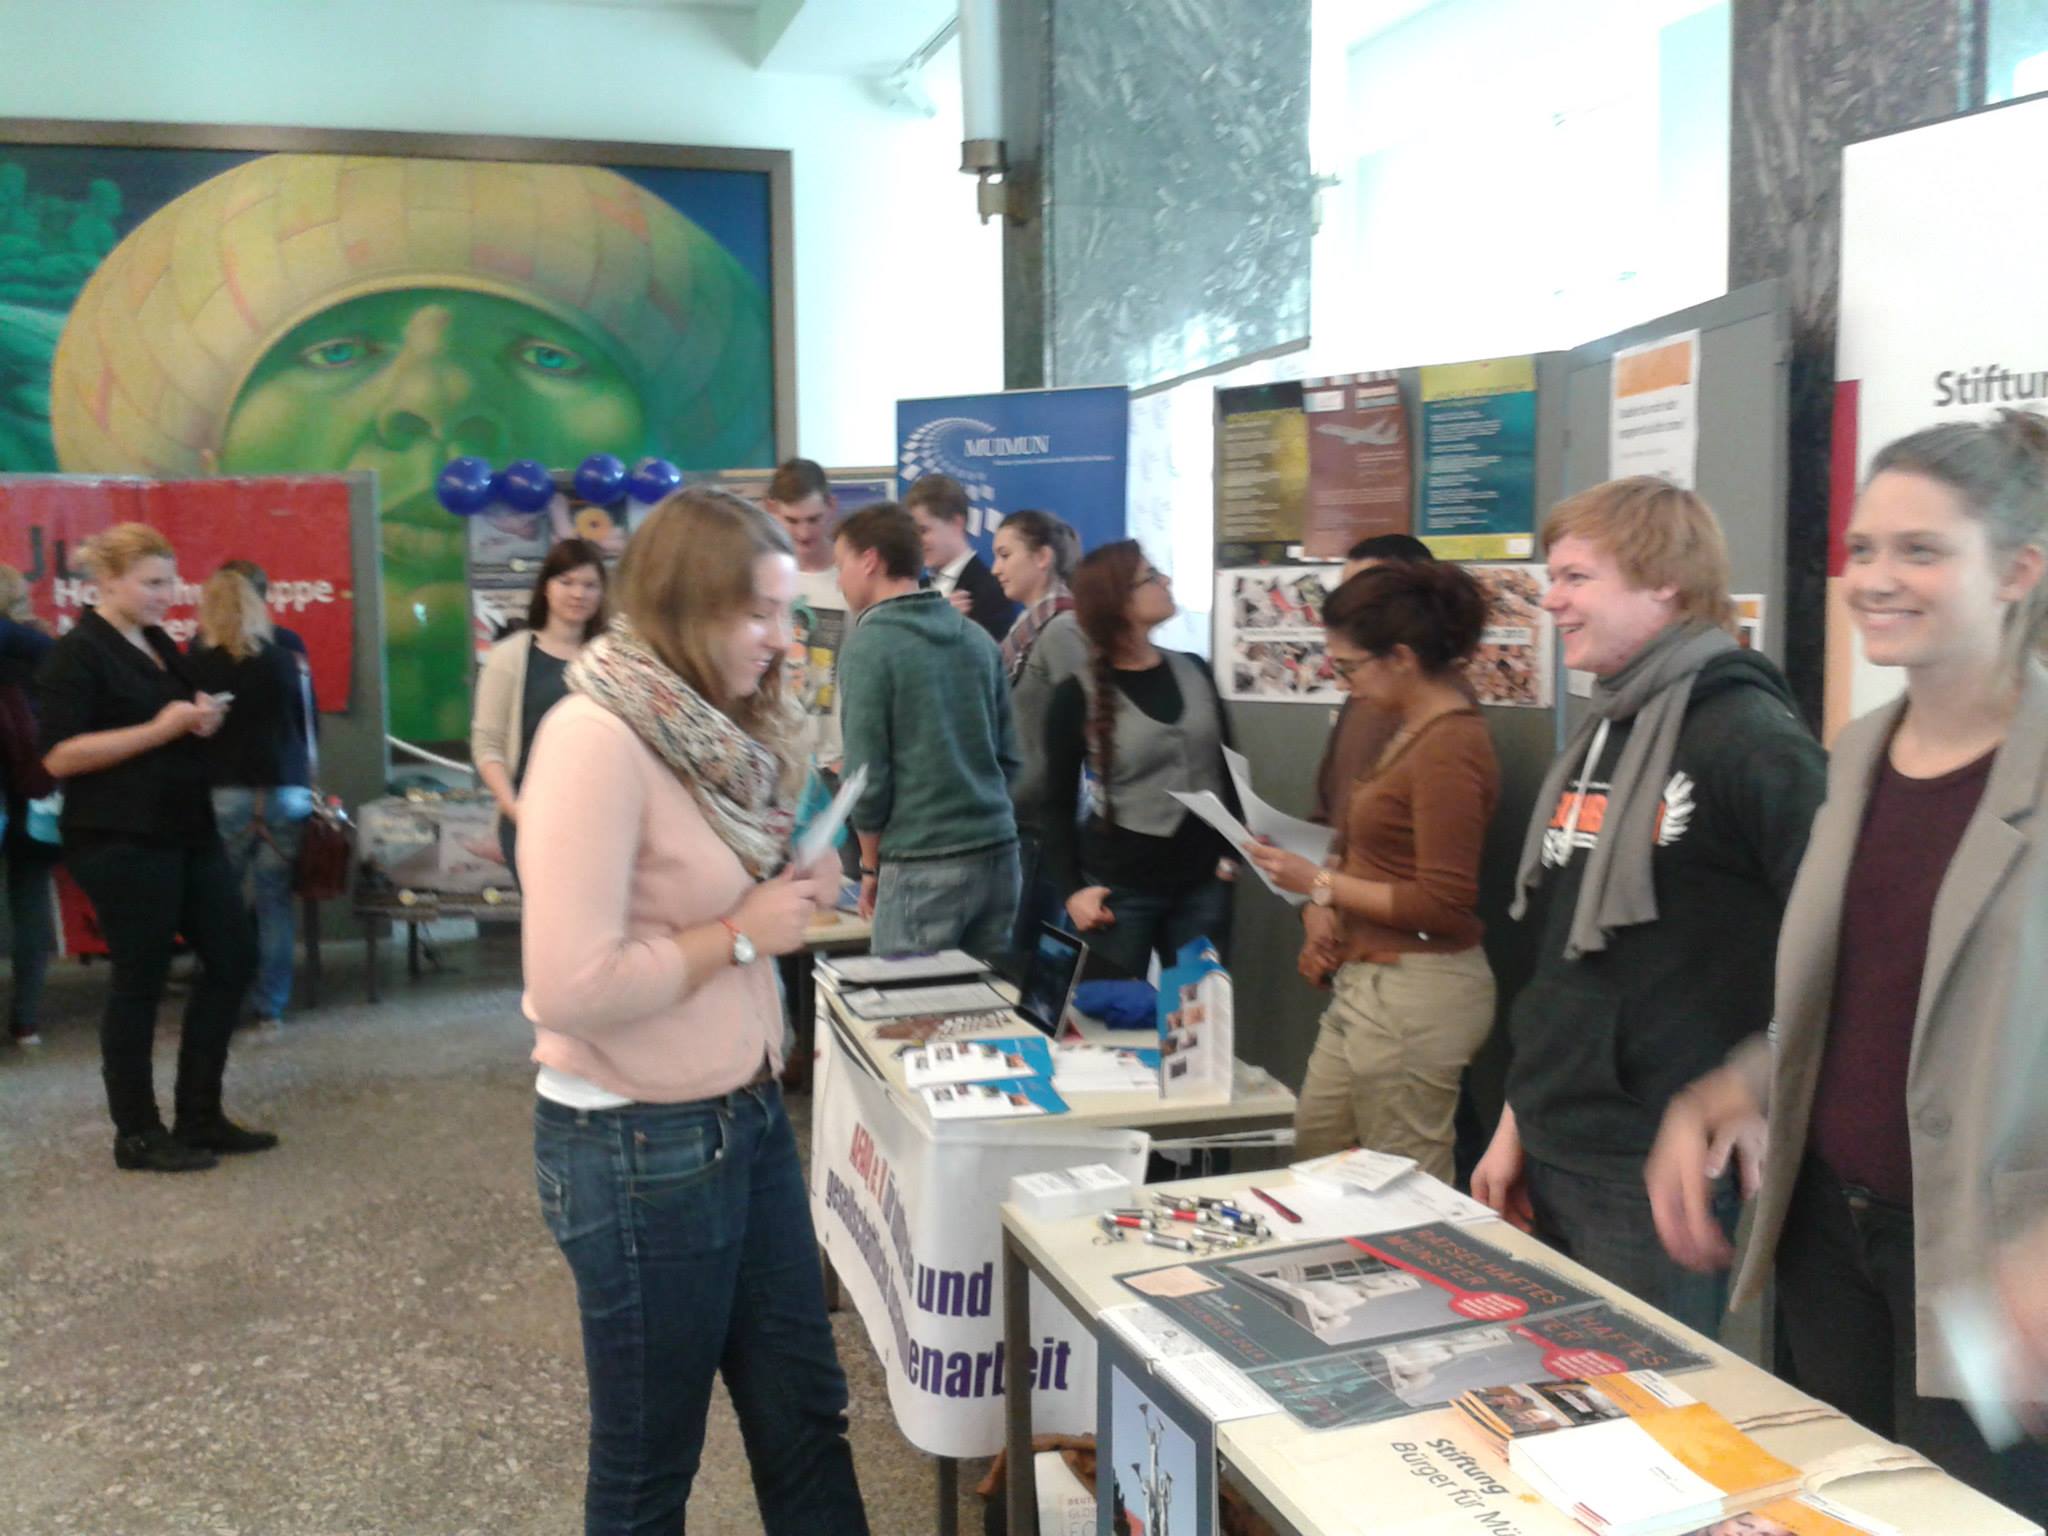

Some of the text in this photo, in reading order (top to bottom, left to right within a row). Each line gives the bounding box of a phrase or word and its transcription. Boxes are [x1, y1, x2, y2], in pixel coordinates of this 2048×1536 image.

[917, 1262, 994, 1317] und
[1390, 1441, 1457, 1488] Bürger
[1447, 1488, 1486, 1509] für
[1425, 1438, 1510, 1495] Stiftung
